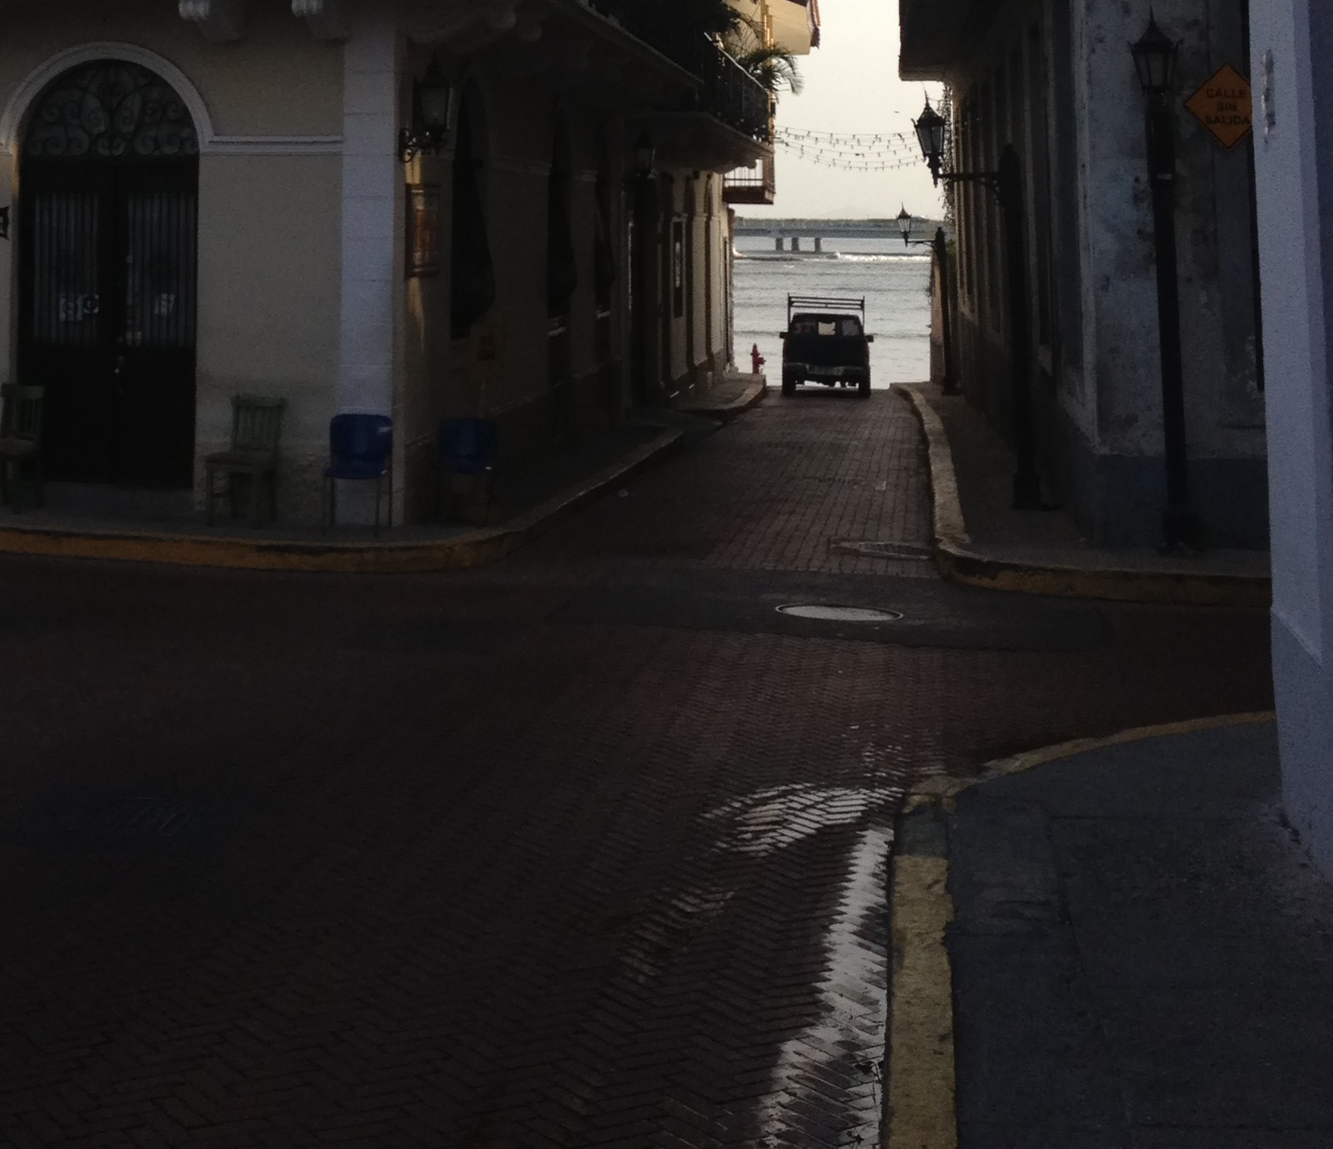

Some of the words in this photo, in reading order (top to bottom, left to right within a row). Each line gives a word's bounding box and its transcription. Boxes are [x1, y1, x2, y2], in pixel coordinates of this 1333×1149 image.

[1205, 88, 1247, 99] CALLE
[1216, 101, 1238, 111] SIN
[1204, 115, 1251, 126] SALIDA
